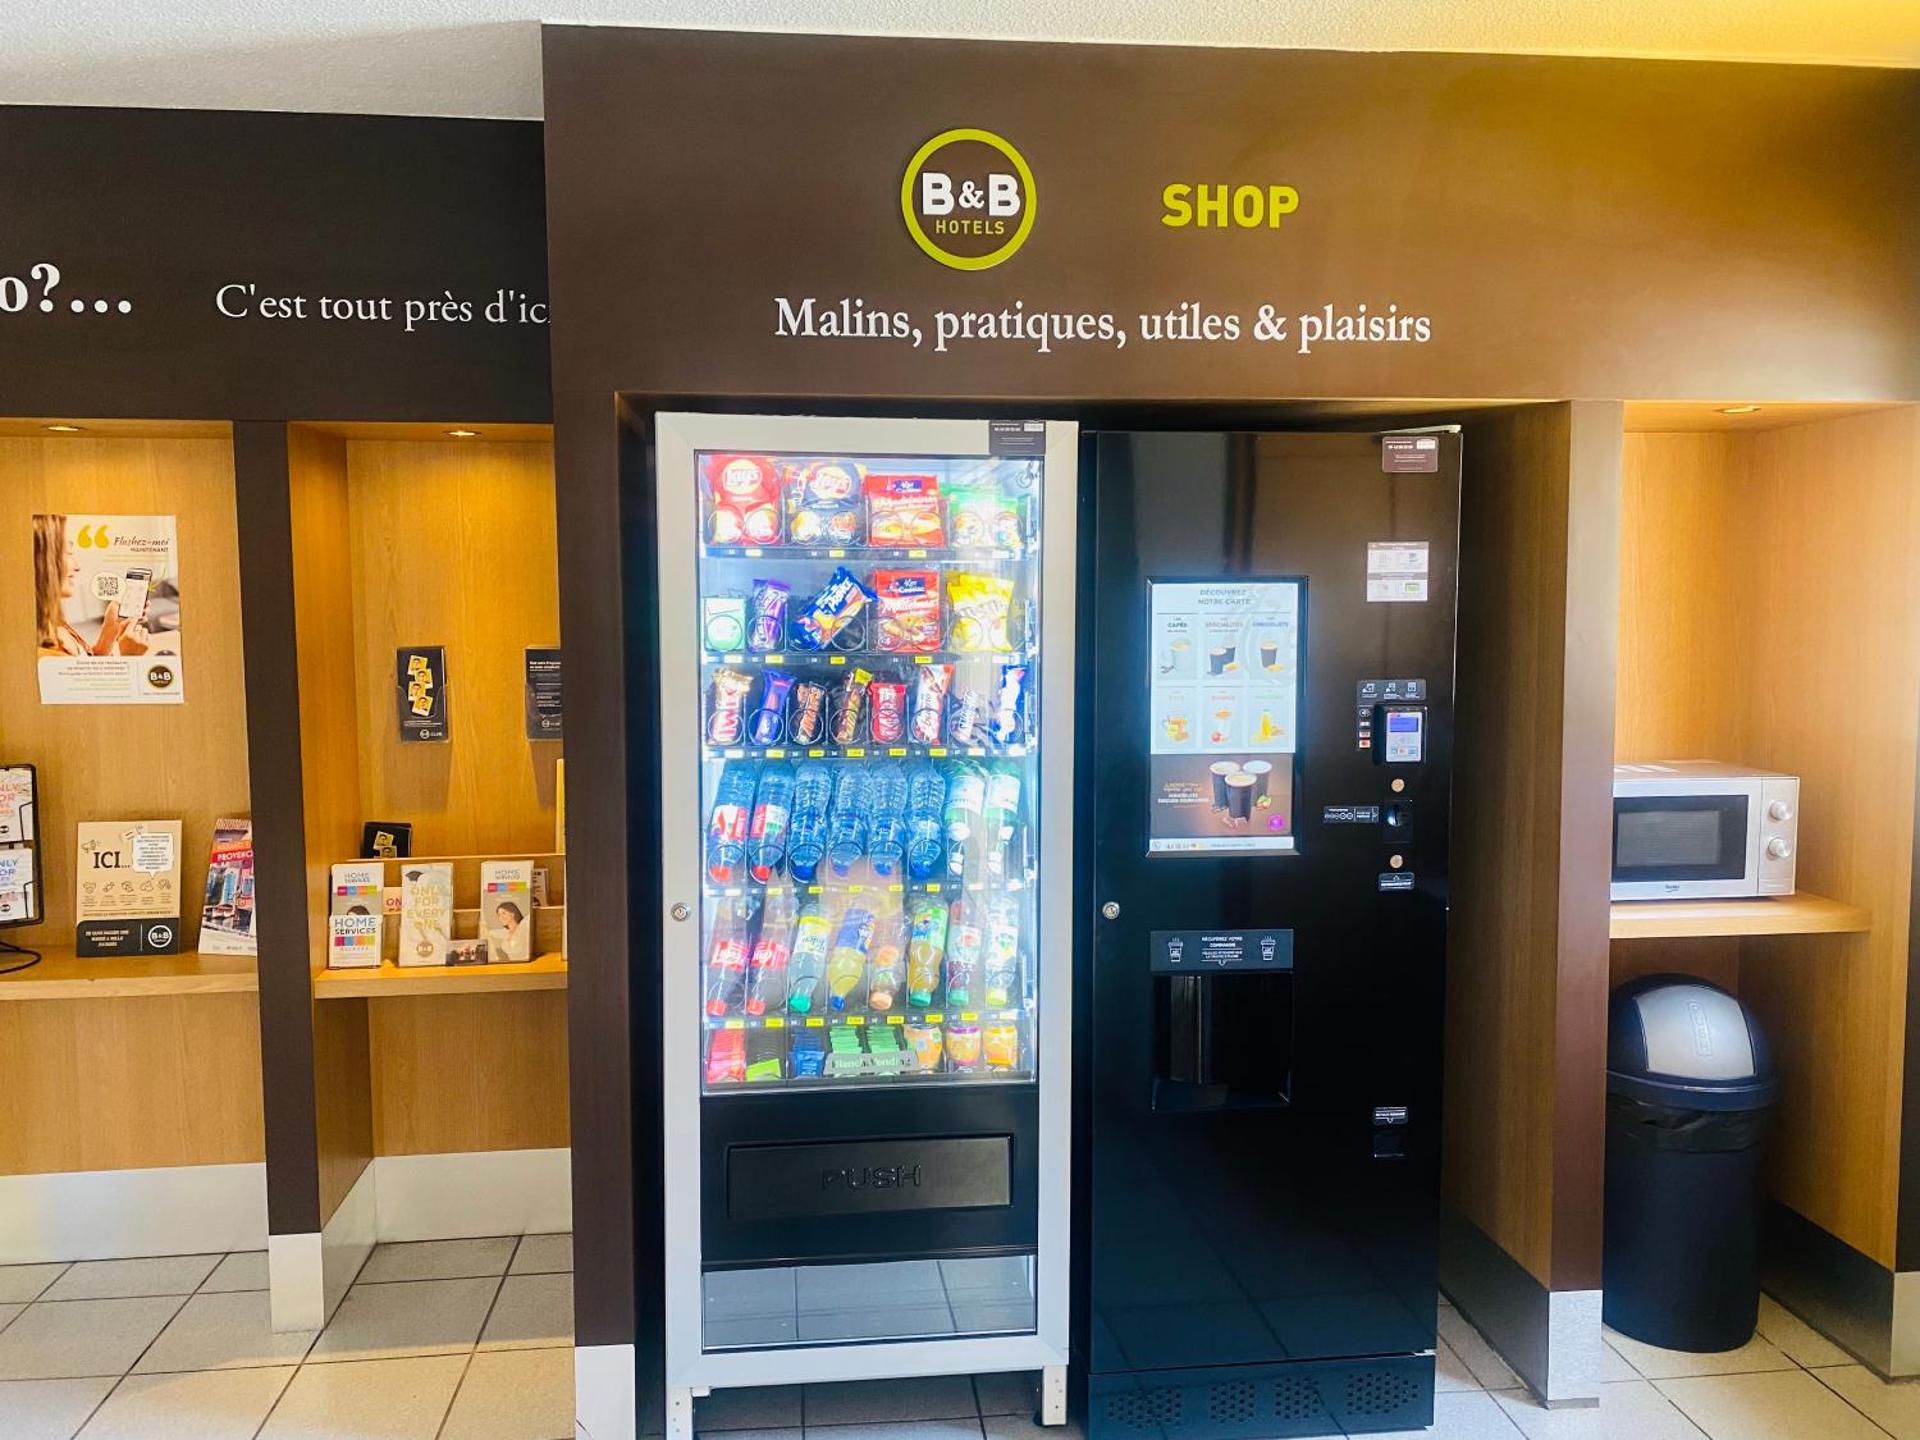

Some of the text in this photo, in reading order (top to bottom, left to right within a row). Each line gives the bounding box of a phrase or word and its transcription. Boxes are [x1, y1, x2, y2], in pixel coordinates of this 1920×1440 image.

[921, 172, 1020, 216] B&B
[1161, 183, 1300, 229] SHOP
[934, 219, 1005, 235] HOTELS
[215, 283, 550, 332] C'est tout près d'ic
[774, 296, 1432, 354] Malins, pratiques, utiles & plaisirs
[334, 917, 377, 927] HOME
[334, 927, 377, 935] SERVICES
[821, 1164, 922, 1190] PUSH
